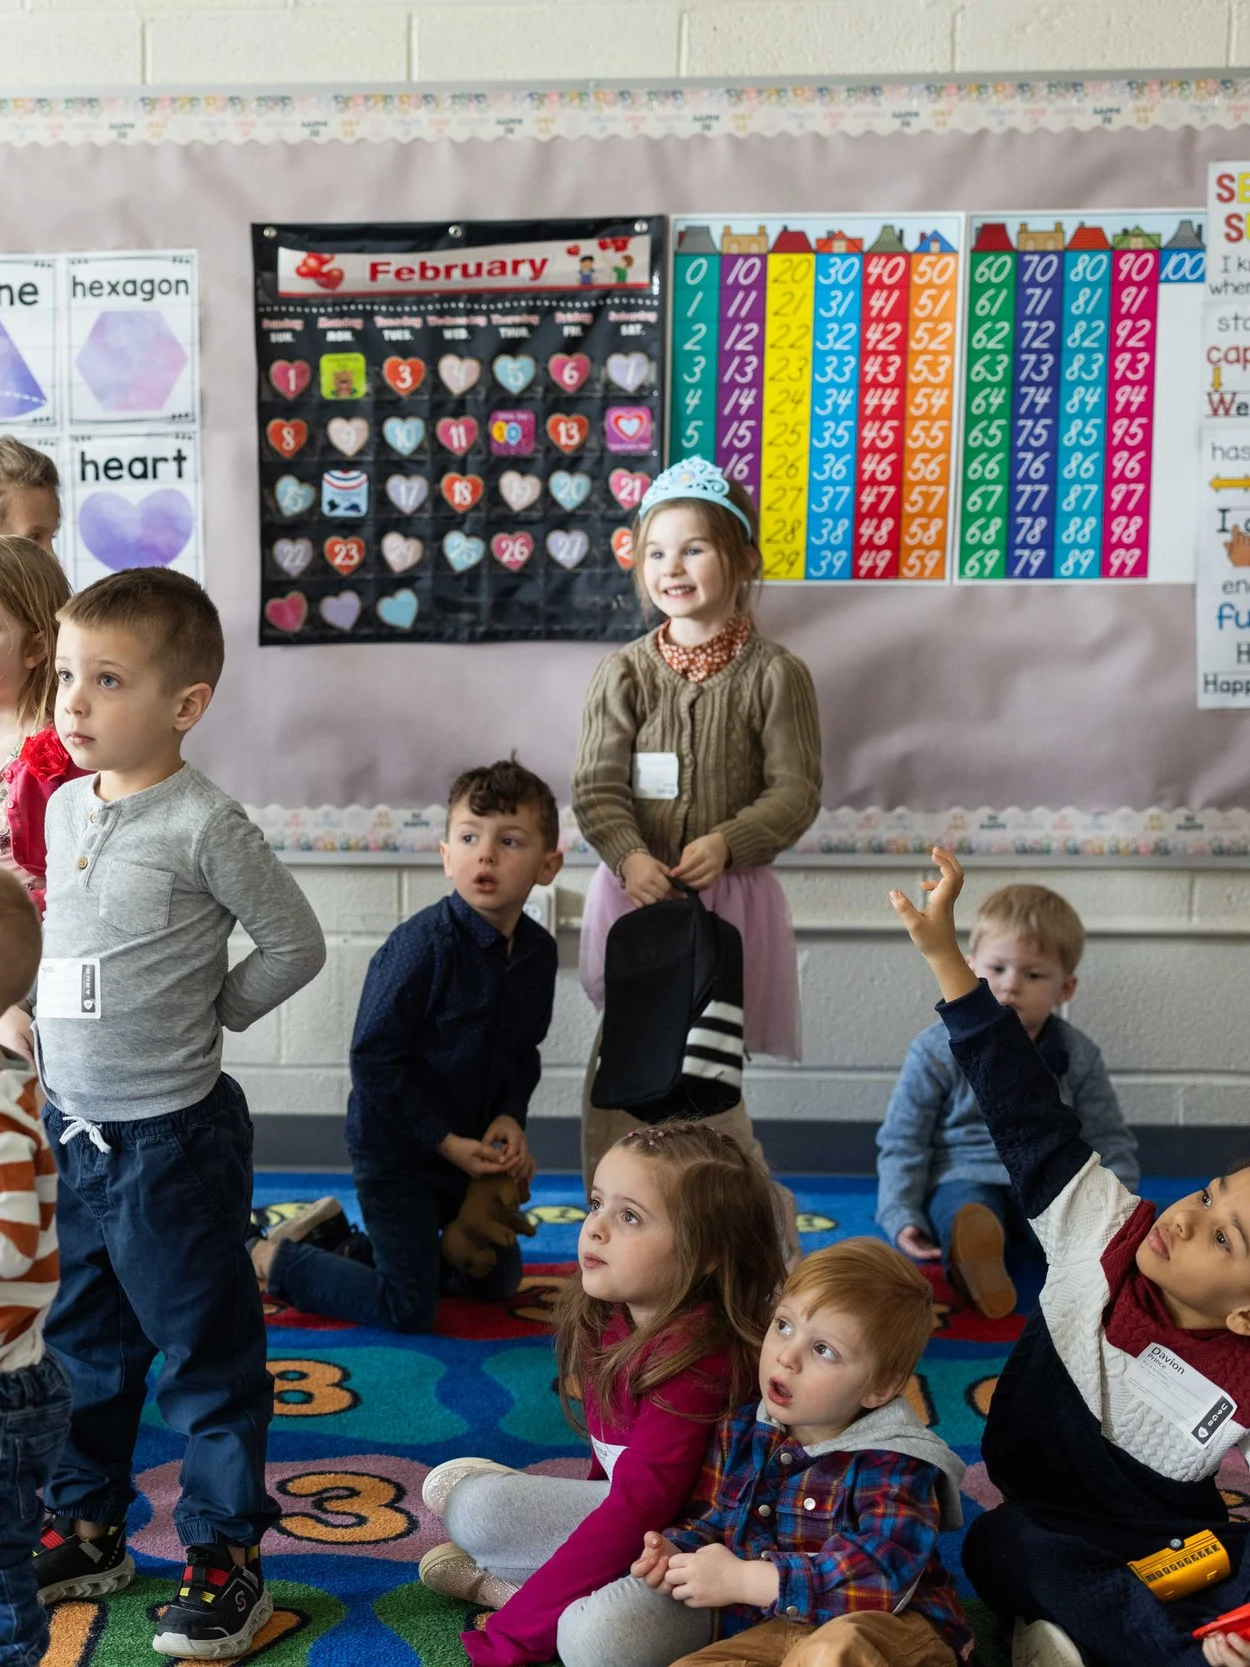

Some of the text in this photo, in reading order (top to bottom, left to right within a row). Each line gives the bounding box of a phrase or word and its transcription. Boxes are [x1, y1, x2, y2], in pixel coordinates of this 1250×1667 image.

[368, 257, 549, 282] February
[686, 256, 955, 285] 0 10 30 40 50
[975, 255, 1012, 283] 60
[1023, 255, 1058, 282] 70
[1070, 254, 1107, 281] 80
[1119, 253, 1154, 281] 90
[1160, 253, 1205, 280] 100
[72, 276, 189, 301] hexagon
[975, 286, 1148, 316] 61 71 81 91
[687, 289, 950, 318] 1 11 31 41 51
[683, 323, 707, 350] 2
[725, 323, 759, 350] 12
[816, 323, 857, 350] 32
[866, 323, 901, 350] 42
[910, 322, 953, 350] 52
[972, 319, 1151, 349] 62 72 82 92
[287, 361, 579, 391] 1 3 5 6
[683, 355, 951, 383] 3 13 33 43 53
[971, 352, 1150, 382] 63 73 83 93
[686, 388, 947, 416] 4 14 34 44 54
[971, 385, 1147, 414] 64 74 84 94
[1207, 392, 1249, 416] We
[282, 421, 581, 450] 8 10 11 13
[681, 420, 948, 448] 5 15 35 45 55
[968, 418, 1148, 447] 65 75 85 95
[80, 449, 187, 481] heart
[723, 453, 945, 480] 16 36 46 56
[968, 451, 1145, 480] 66 76 86 96
[452, 480, 472, 505] 18
[560, 477, 586, 500] 20
[618, 477, 643, 501] 21
[811, 486, 945, 513] 37 47 57
[967, 483, 1145, 512] 67 77 87 97
[811, 518, 942, 545] 38 48 58
[966, 516, 1142, 544] 68 78 88 98
[333, 543, 360, 566] 23
[501, 539, 528, 562] 26
[810, 550, 940, 577] 39 49 59
[964, 549, 1141, 576] 69 79 89 99
[1147, 1353, 1167, 1370] Prince
[1151, 1346, 1185, 1375] Davion
